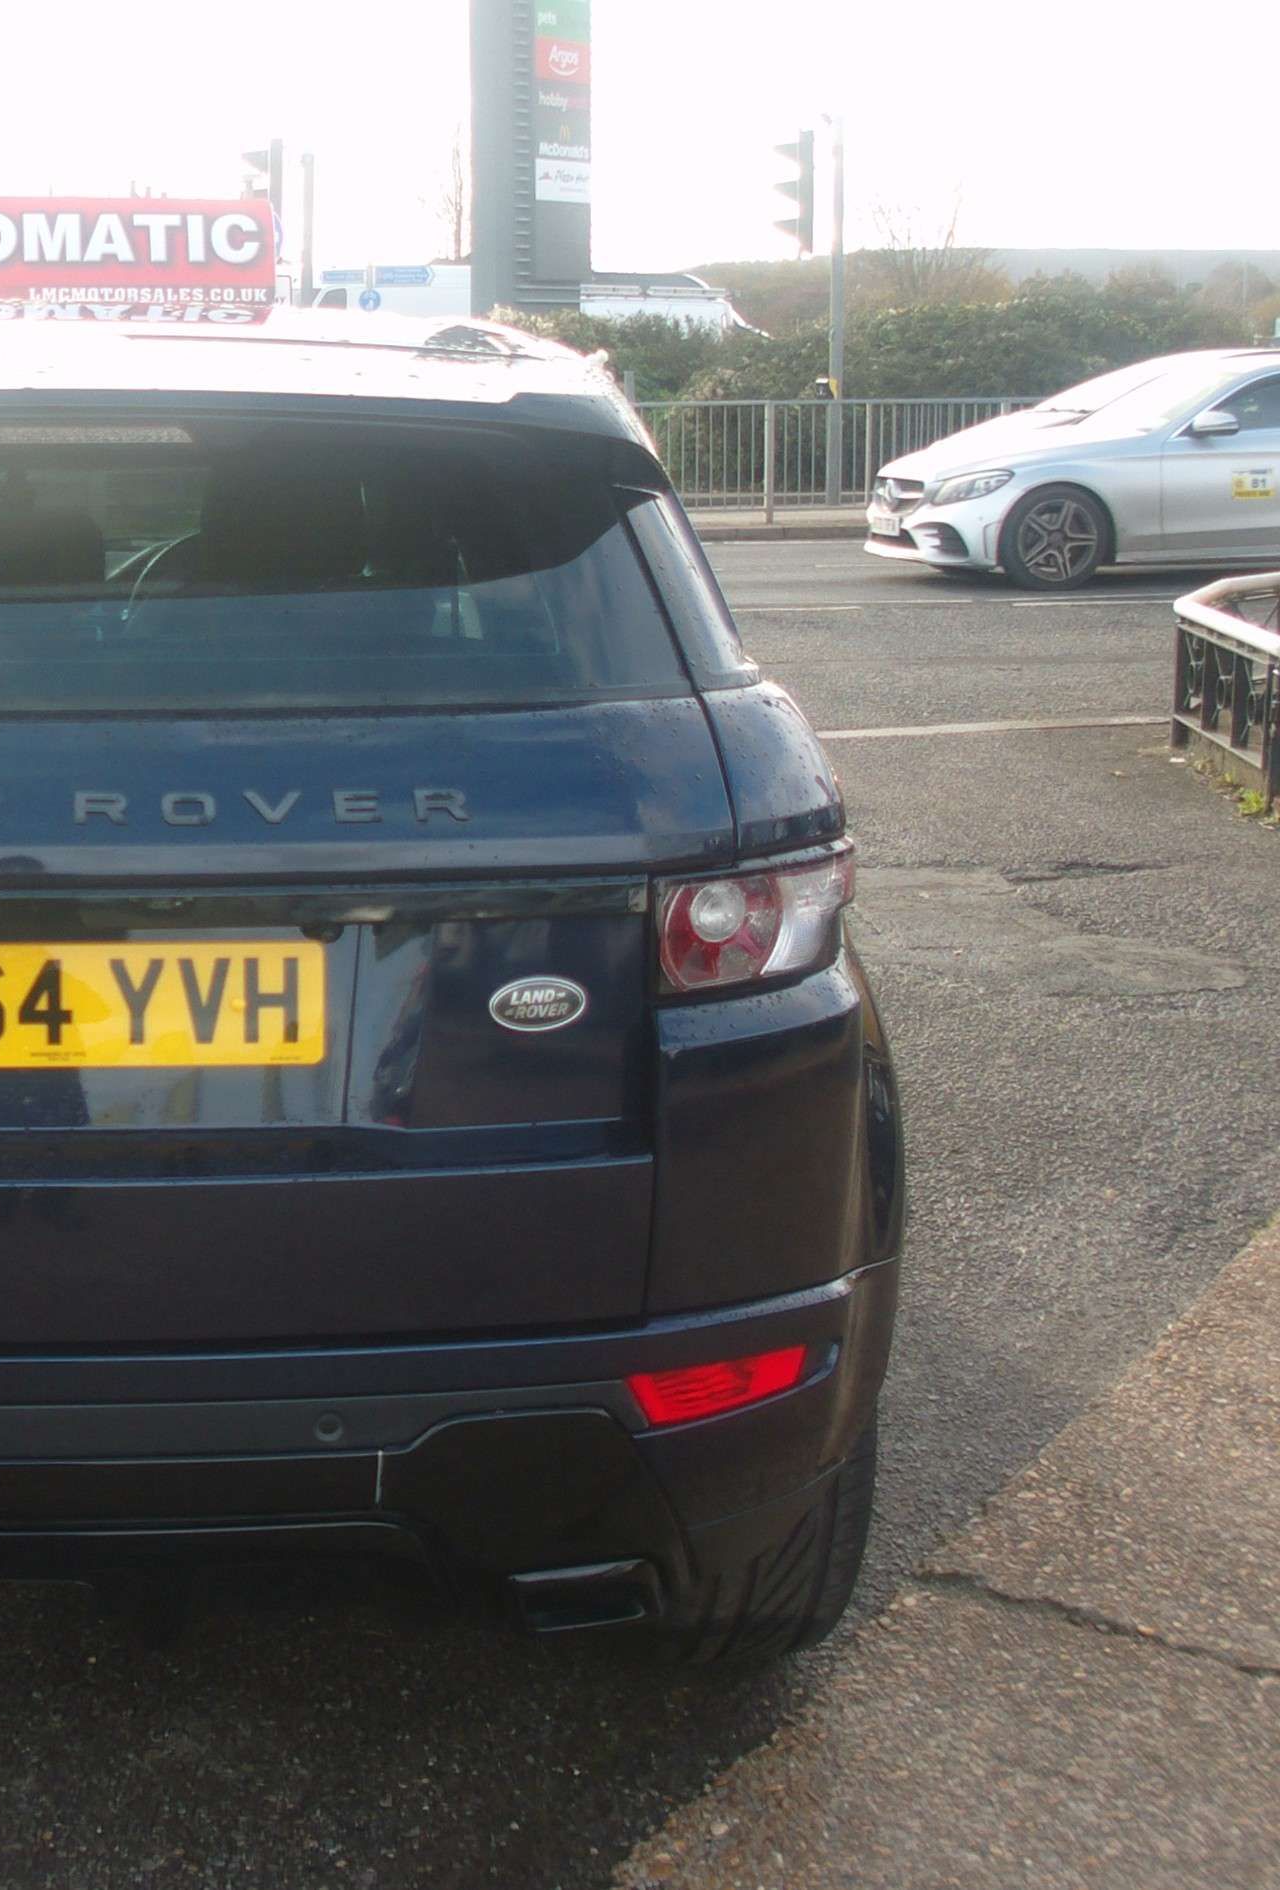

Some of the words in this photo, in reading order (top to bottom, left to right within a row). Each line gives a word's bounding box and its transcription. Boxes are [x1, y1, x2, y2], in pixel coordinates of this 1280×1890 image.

[548, 44, 579, 69] Argos
[72, 788, 472, 827] ROVER
[108, 957, 300, 1046] YVH
[509, 988, 556, 1006] LAND
[513, 1002, 569, 1019] ROVER
